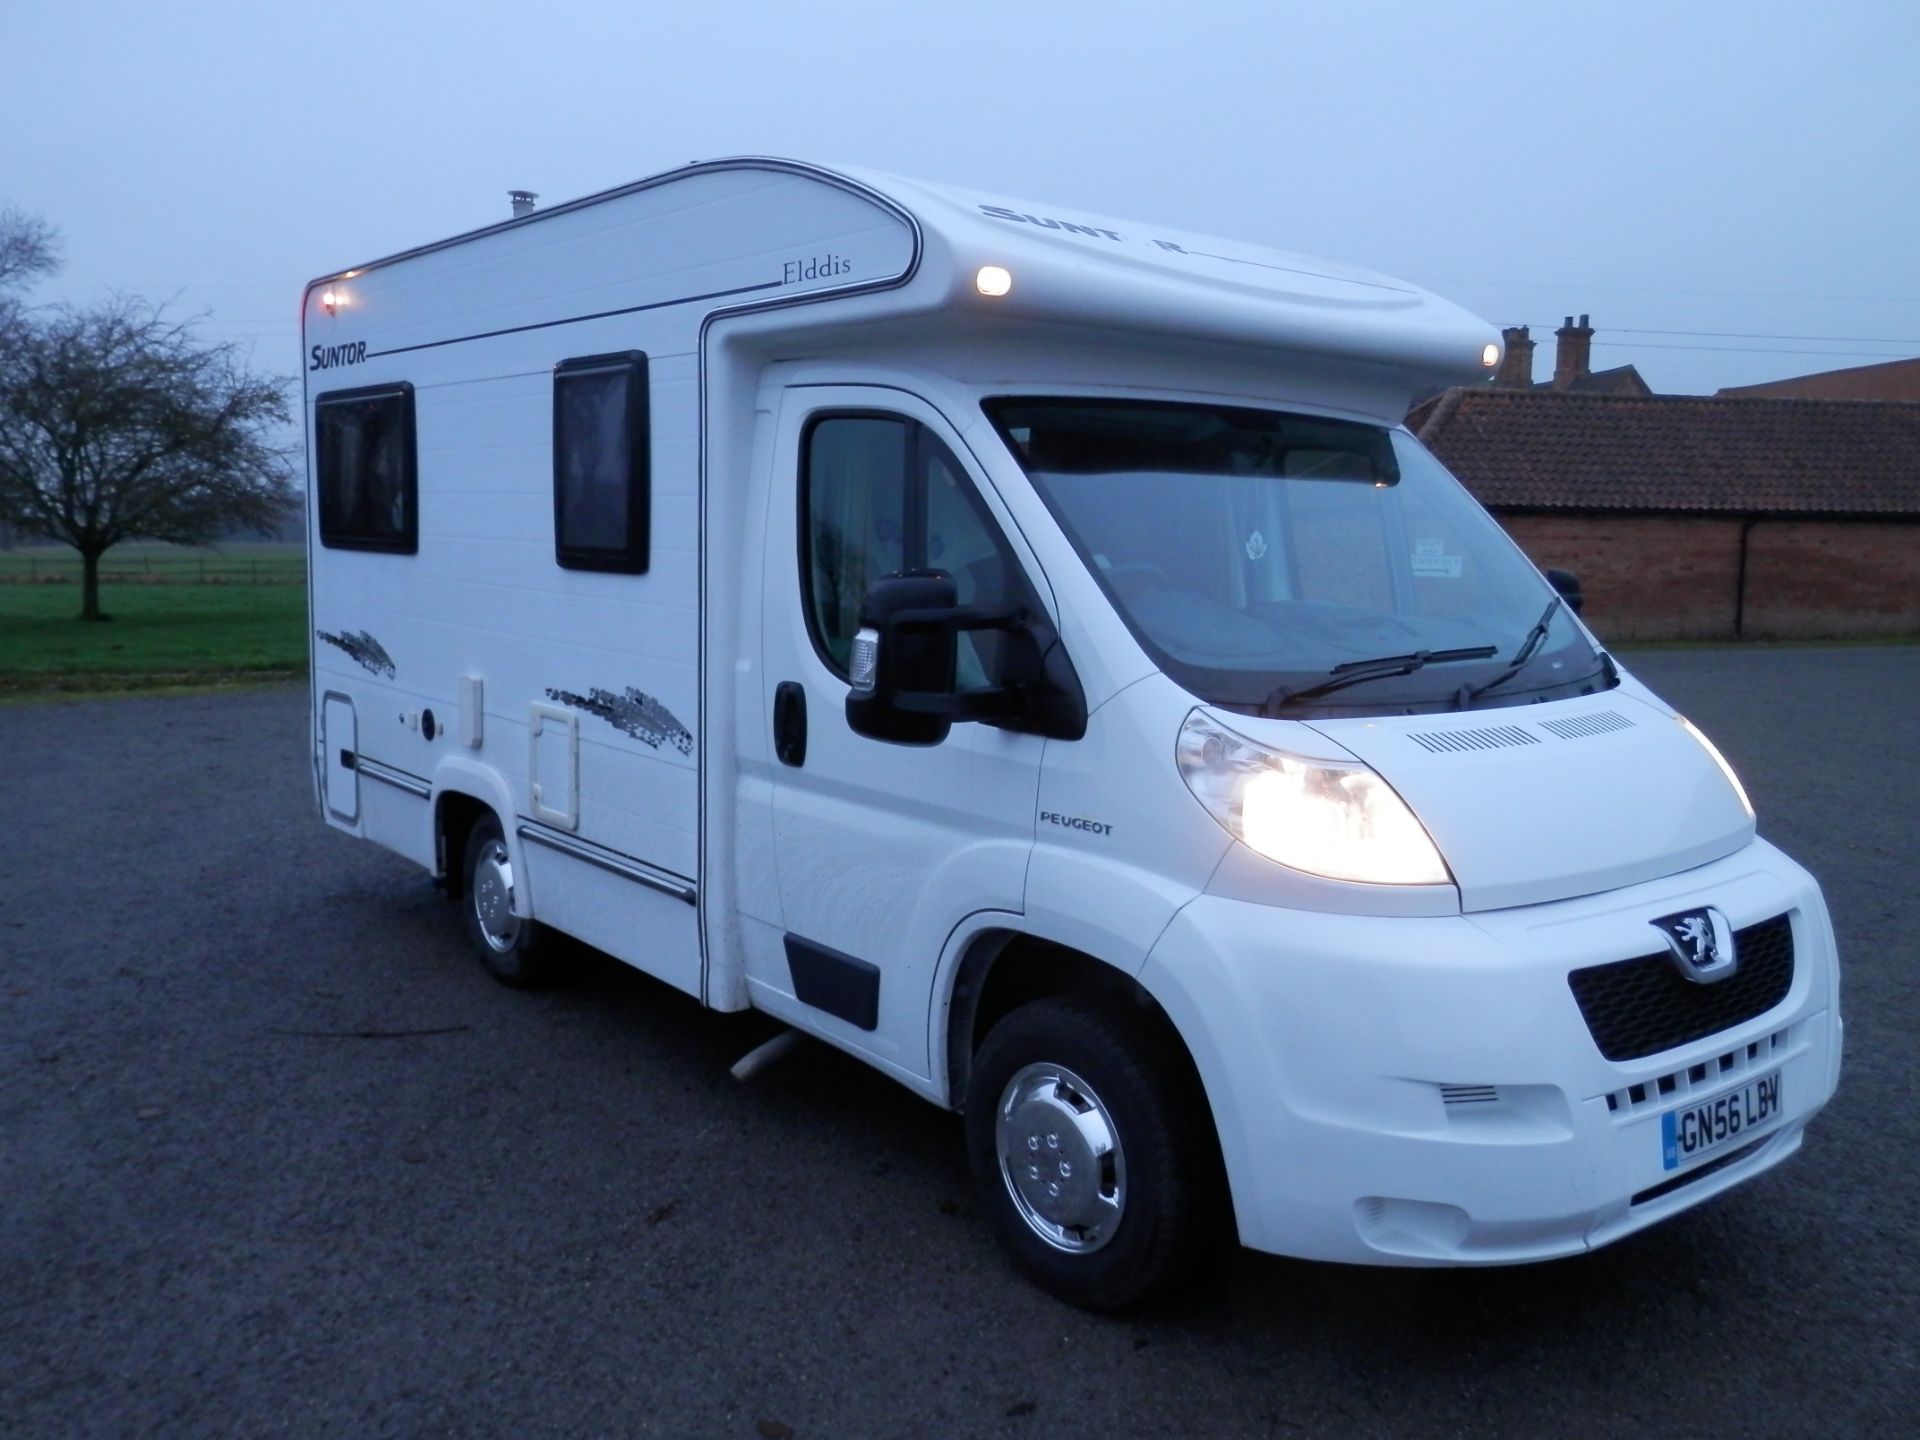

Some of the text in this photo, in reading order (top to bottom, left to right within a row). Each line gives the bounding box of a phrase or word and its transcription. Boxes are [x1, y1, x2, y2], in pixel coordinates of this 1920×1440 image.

[783, 254, 851, 284] Elddis
[310, 340, 366, 371] SUNTOR
[1040, 811, 1113, 836] PEUGEOT
[1682, 1073, 1778, 1153] GN56 LBV
